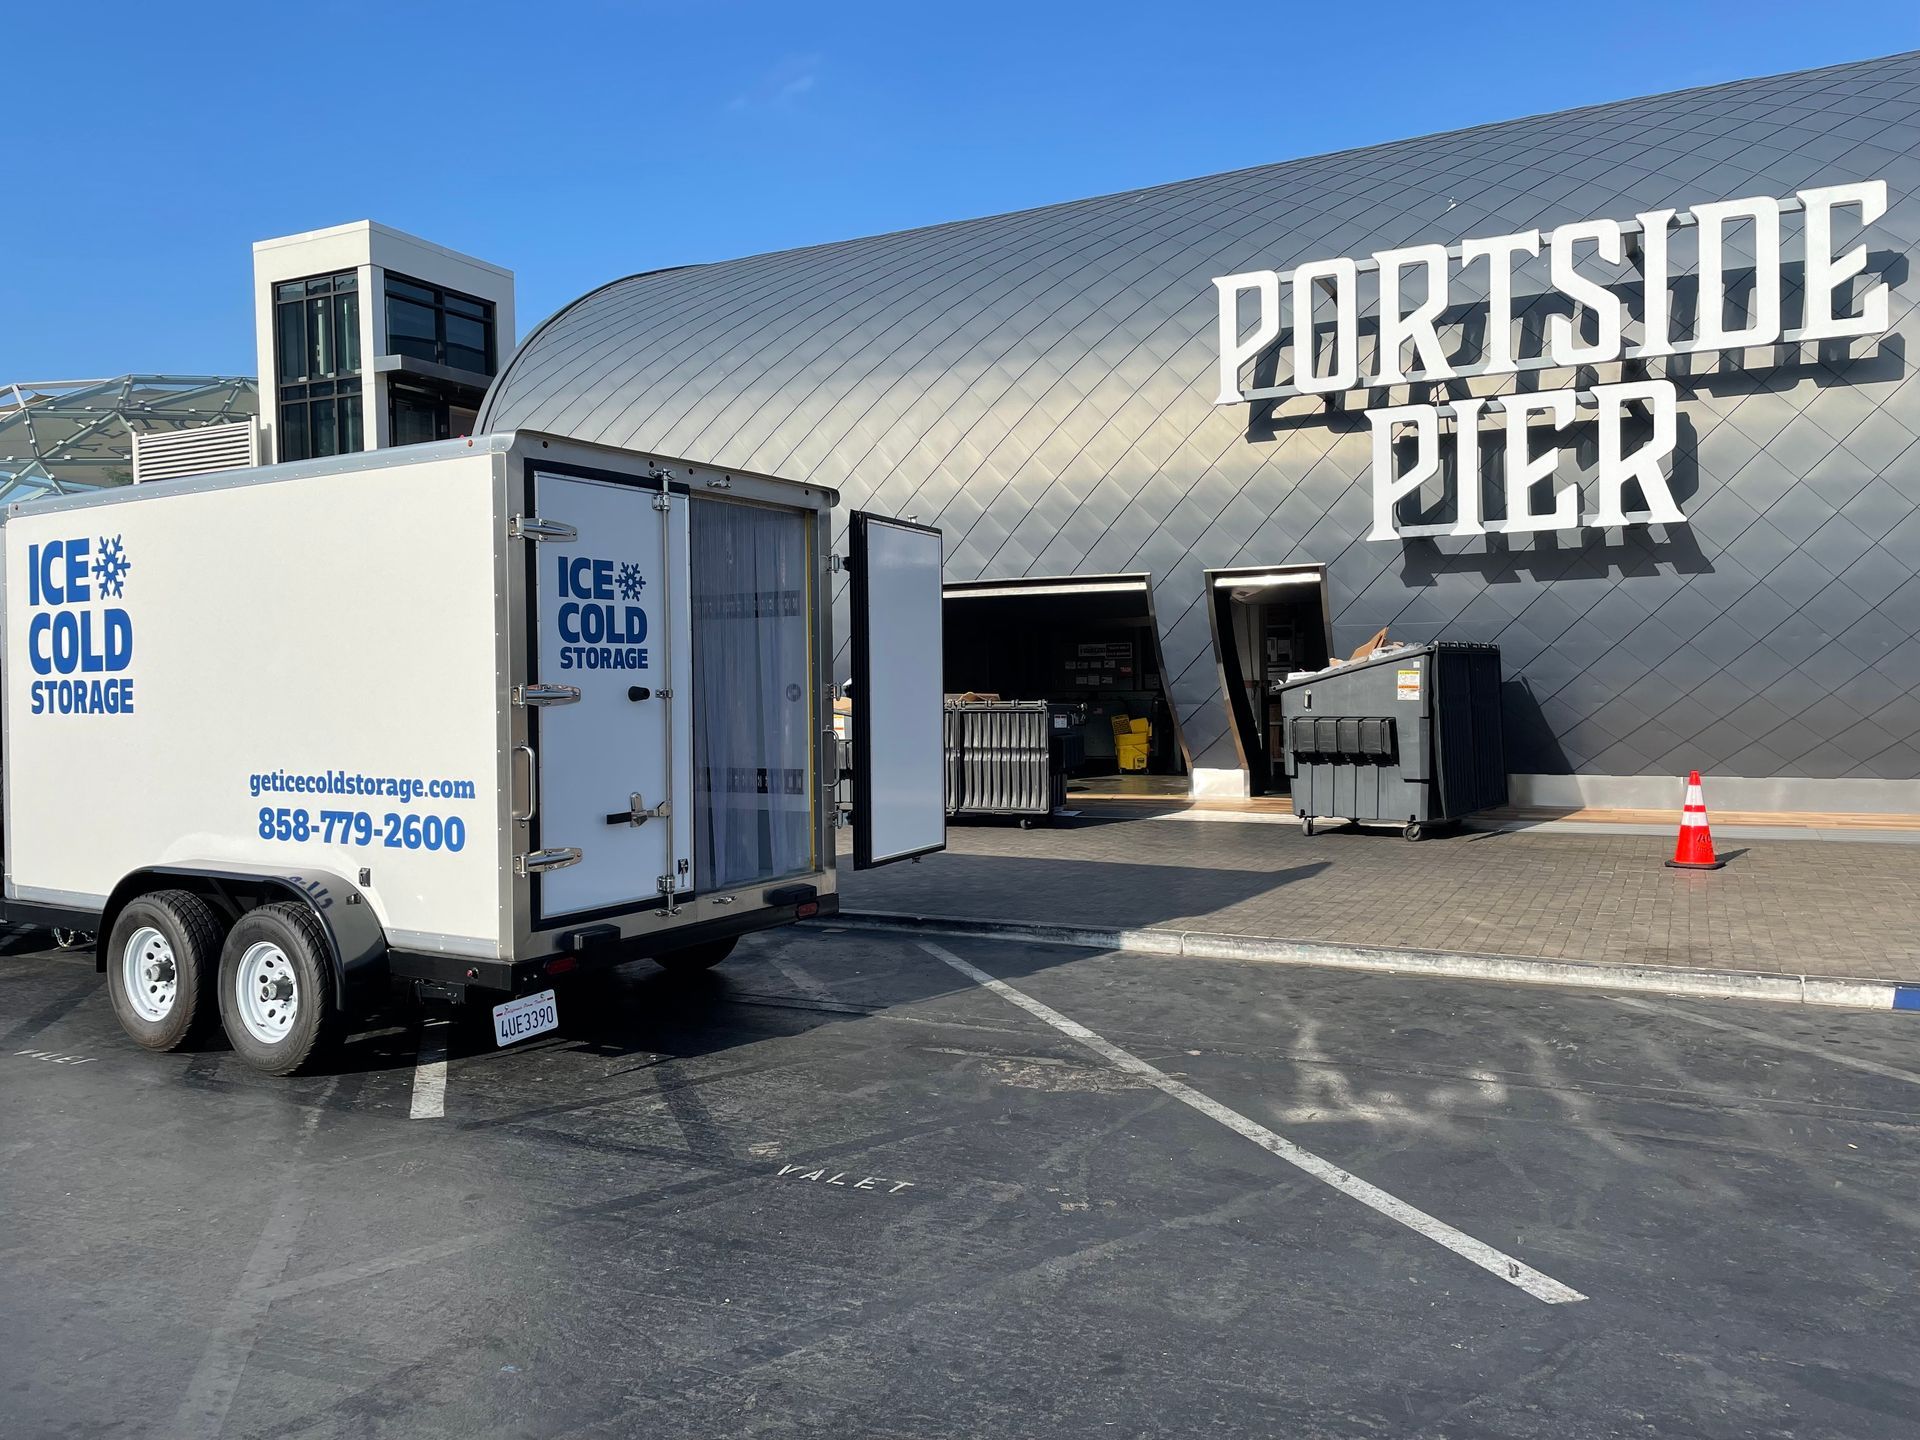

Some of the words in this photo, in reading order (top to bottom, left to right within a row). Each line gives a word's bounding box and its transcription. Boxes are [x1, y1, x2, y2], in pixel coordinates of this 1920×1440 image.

[1211, 179, 1889, 405] PORTSIDE
[1363, 379, 1688, 542] PIER
[29, 538, 91, 606] ICE
[557, 555, 615, 601] ICE
[29, 608, 133, 675] COLD
[557, 601, 648, 645] COLD
[559, 646, 649, 670] STORAGE
[31, 678, 134, 715] STORAGE
[249, 770, 475, 803] geticecoldstorage.com
[258, 807, 466, 852] 858-779-2600
[501, 1005, 554, 1038] 4UE3390
[776, 1163, 915, 1194] VALET
